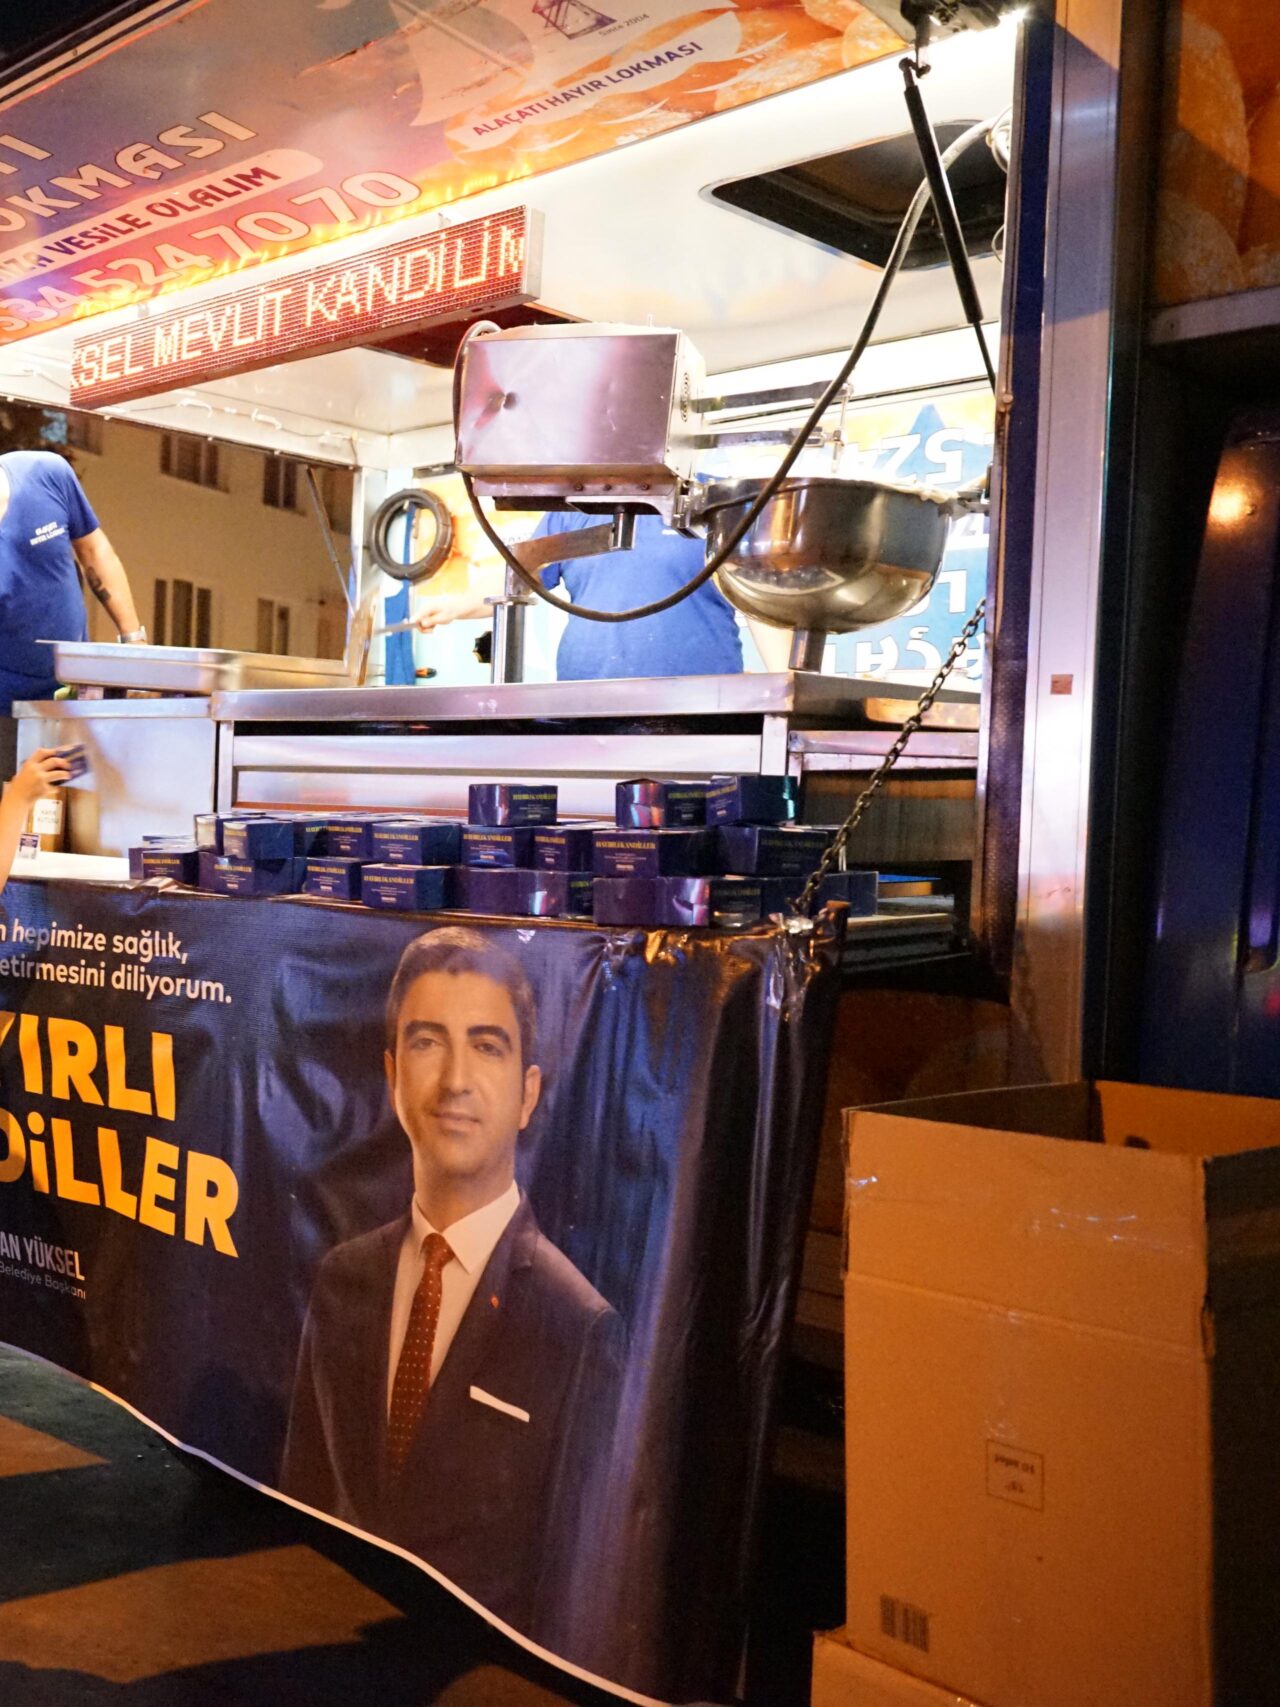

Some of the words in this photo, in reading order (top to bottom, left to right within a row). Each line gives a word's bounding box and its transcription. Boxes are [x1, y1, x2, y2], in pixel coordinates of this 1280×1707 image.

[472, 99, 549, 136] ALAÇATI
[549, 79, 608, 108] HAYIR
[609, 41, 704, 84] LOKMASI
[145, 166, 282, 218] OLALIM
[71, 242, 216, 297] 524
[191, 210, 311, 259] 70
[289, 171, 422, 225] 70
[13, 917, 107, 952] hepimize
[112, 929, 188, 964] sağlık,
[111, 964, 232, 1004] diliyorum.
[23, 1235, 85, 1281] YÜKSEL
[44, 1274, 86, 1299] Başkanı
